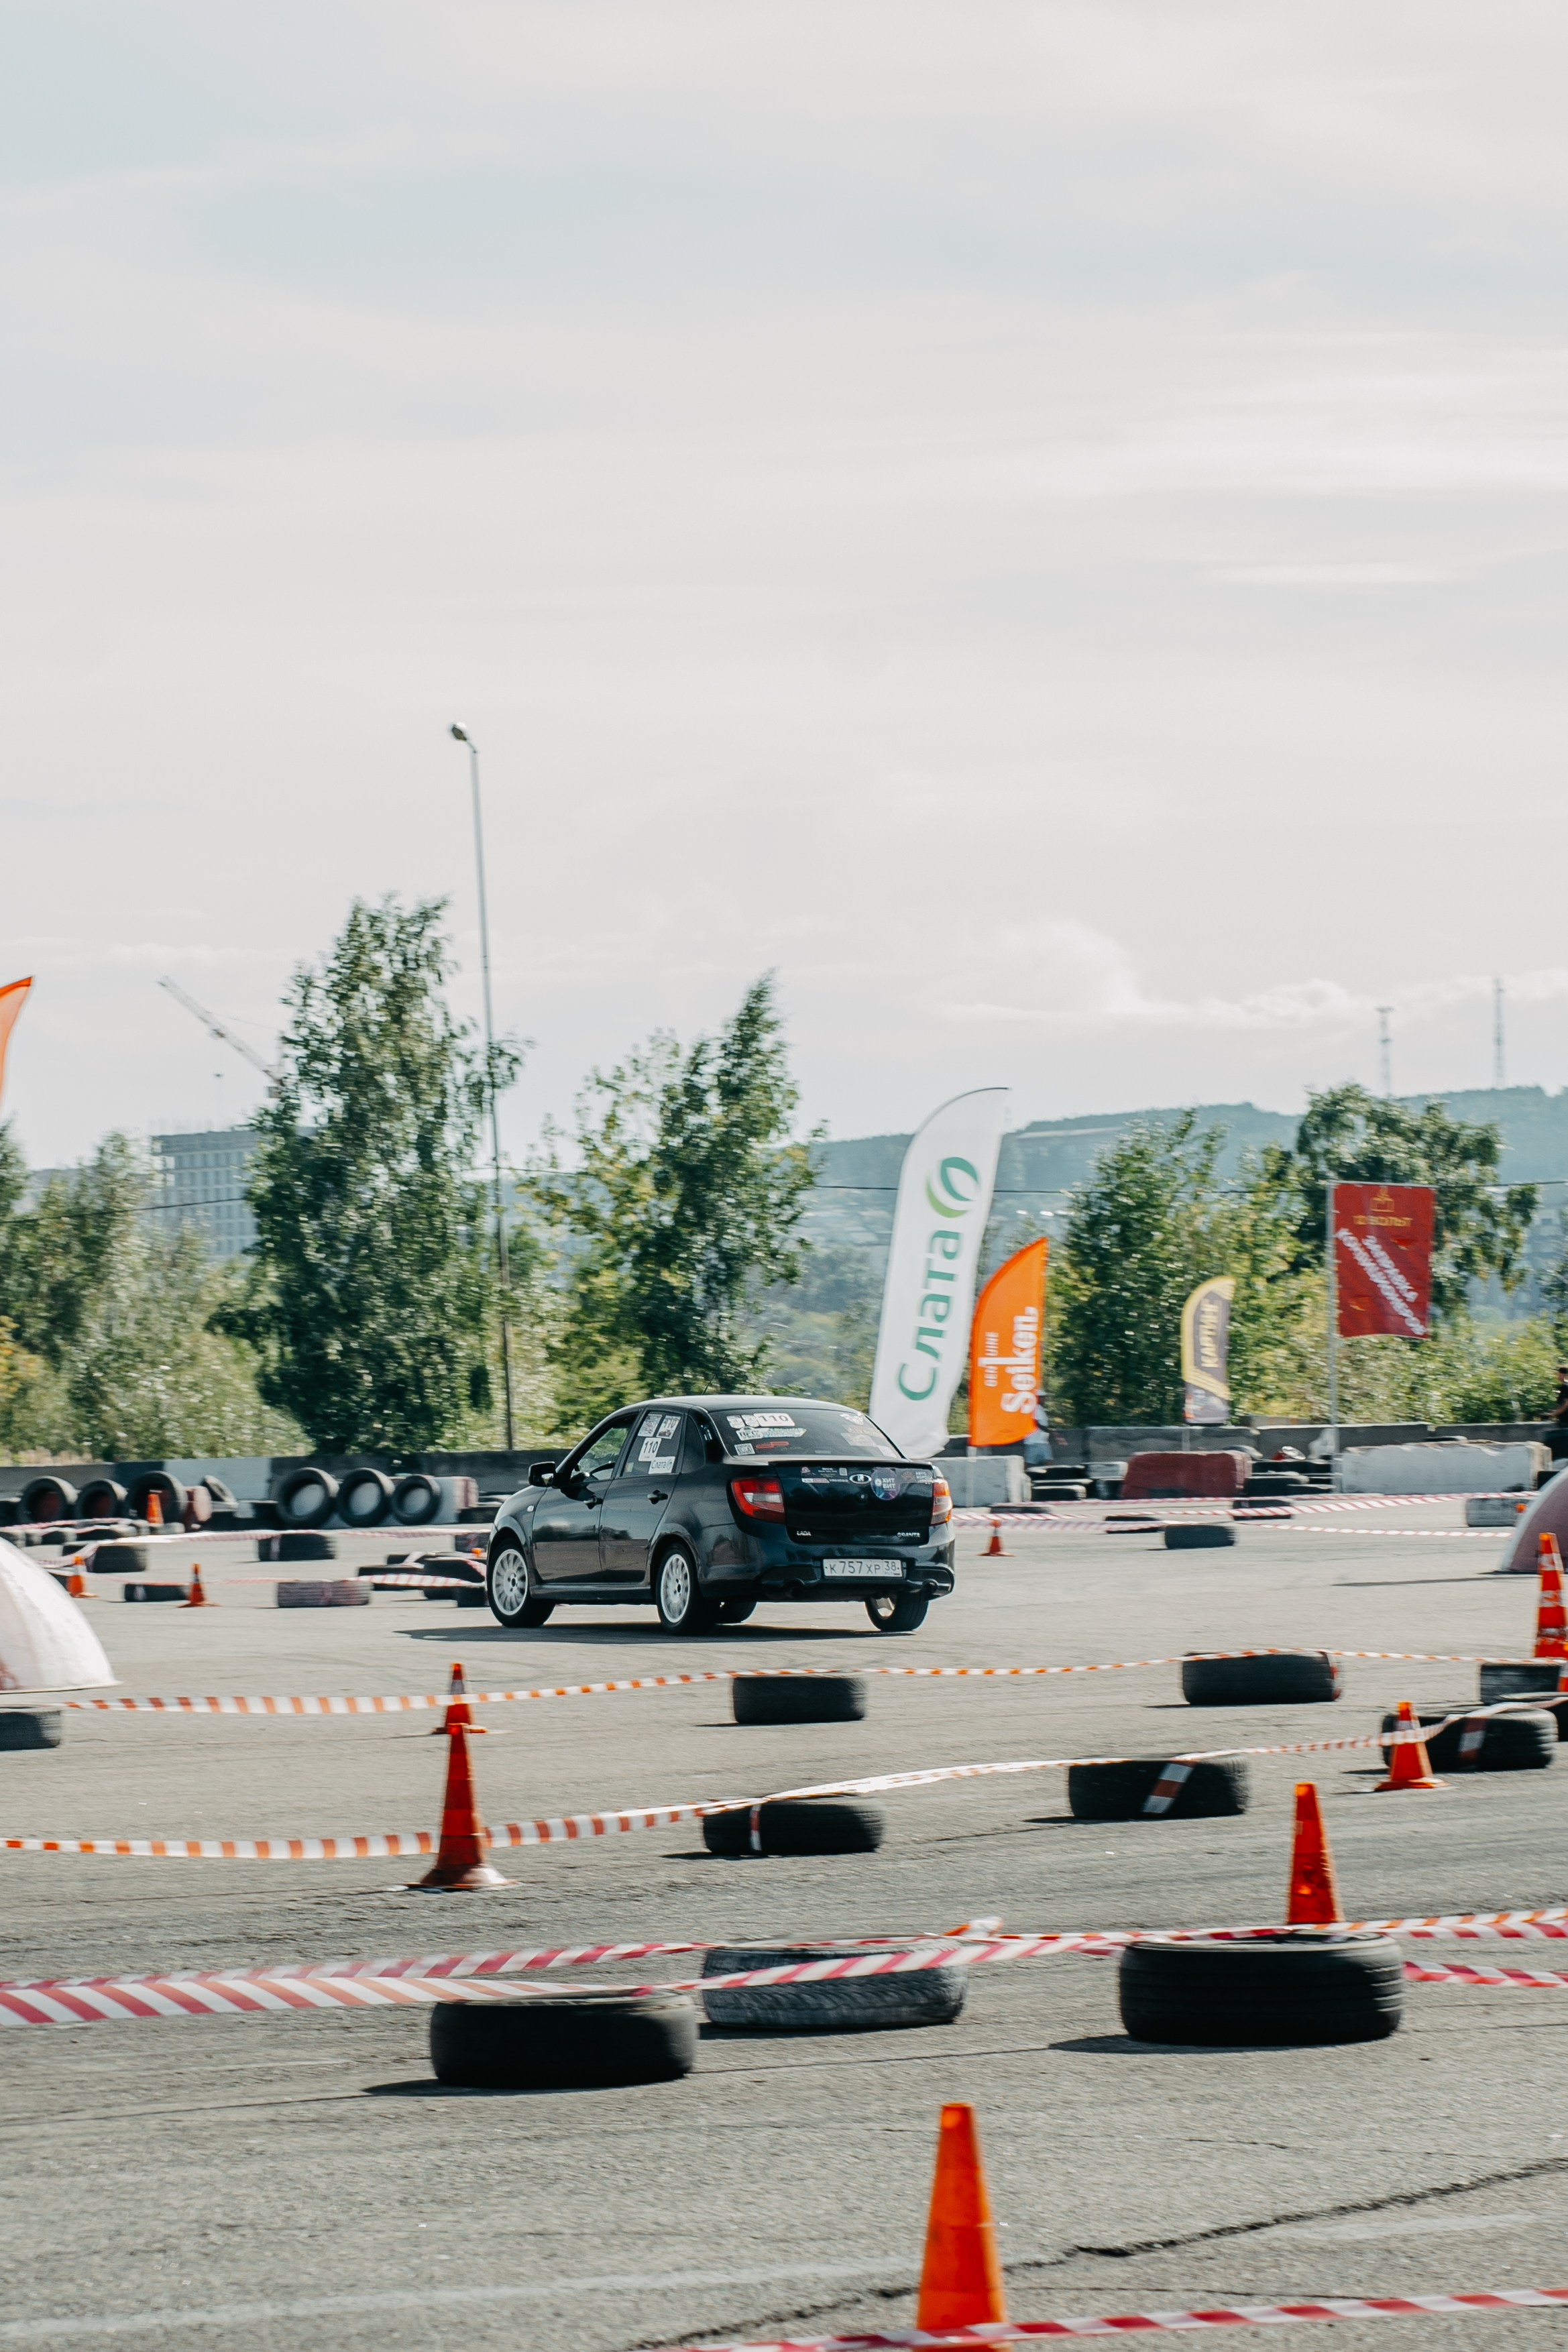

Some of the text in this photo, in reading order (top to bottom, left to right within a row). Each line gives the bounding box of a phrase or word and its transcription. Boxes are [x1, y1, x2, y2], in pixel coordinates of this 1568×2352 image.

[897, 1229, 962, 1401] Слата
[1198, 1298, 1220, 1368] КАРТИНГ
[643, 1441, 659, 1454] 110
